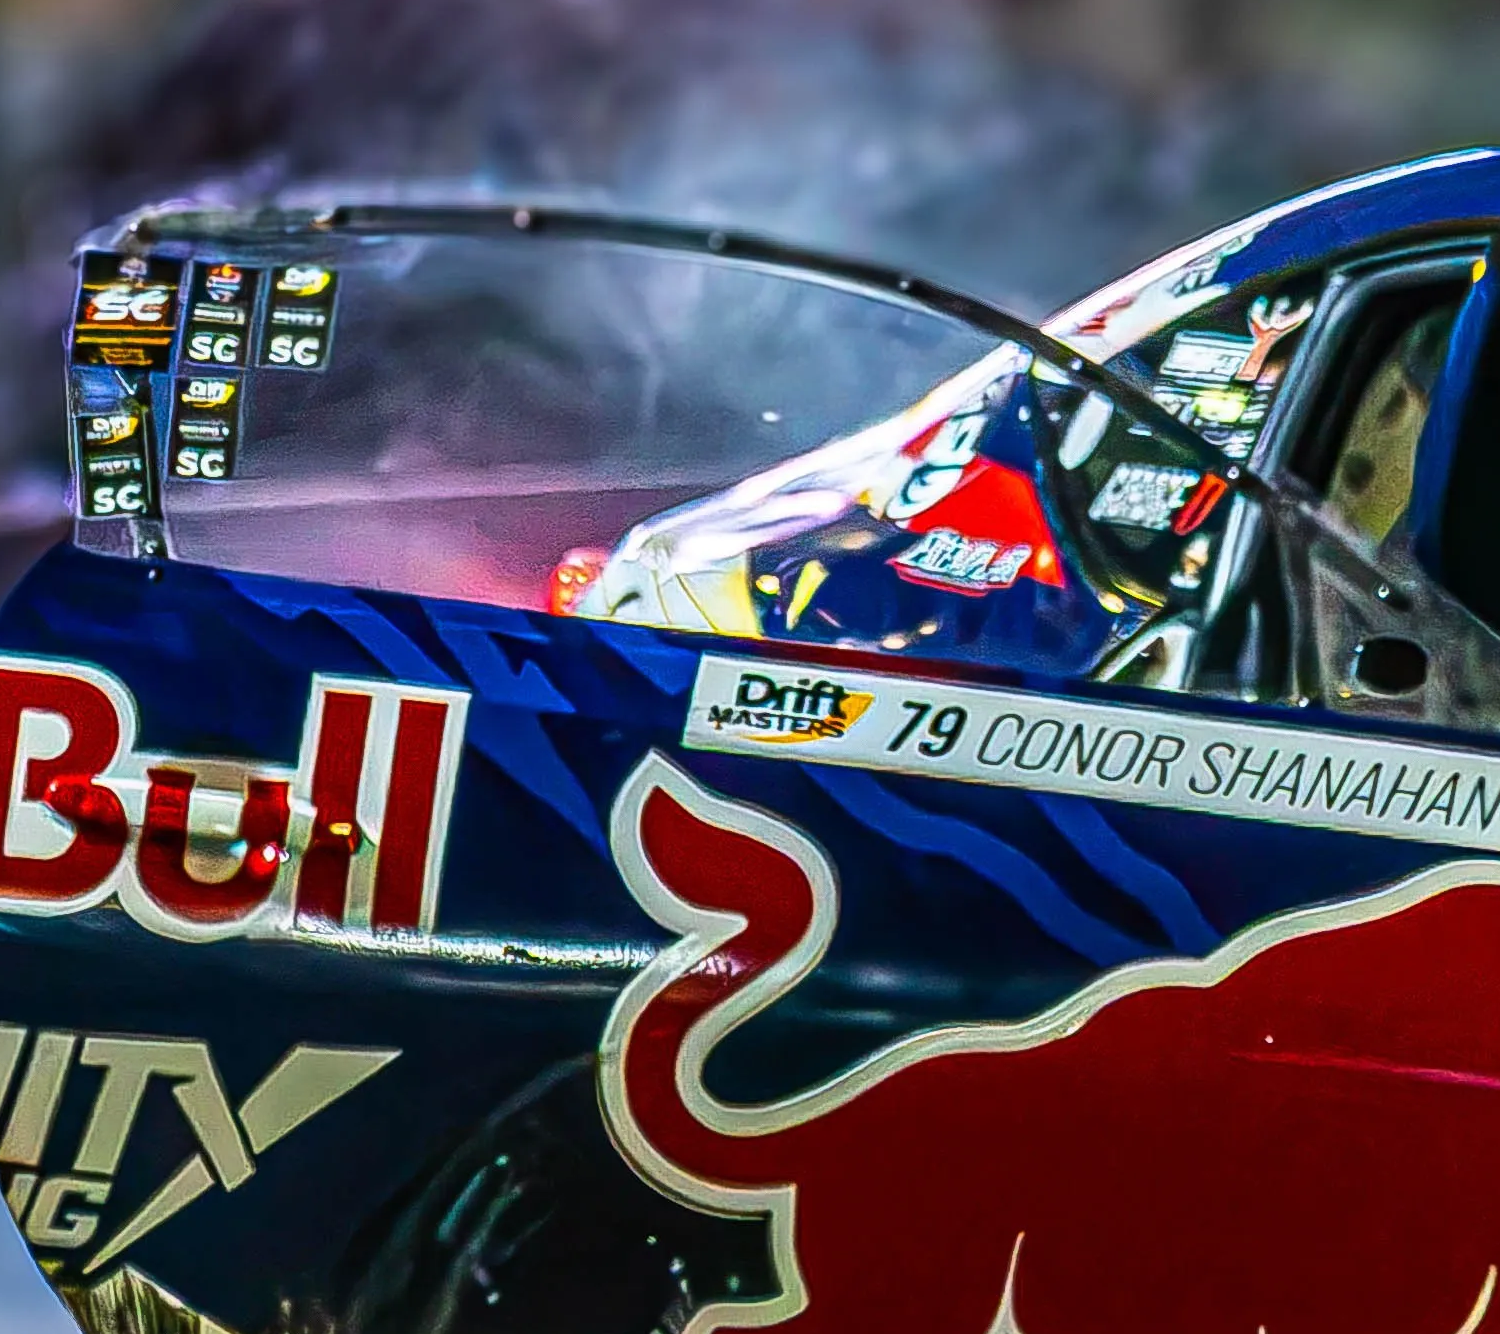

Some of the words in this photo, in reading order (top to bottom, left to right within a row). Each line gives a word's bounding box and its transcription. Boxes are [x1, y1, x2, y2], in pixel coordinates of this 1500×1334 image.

[187, 333, 240, 364] SC
[268, 334, 321, 366] SC
[174, 447, 226, 479] SC
[93, 482, 143, 515] SC
[734, 673, 848, 719] Drift
[706, 704, 847, 739] MASTERS
[886, 700, 969, 758] 79
[976, 712, 1186, 788] CONOR
